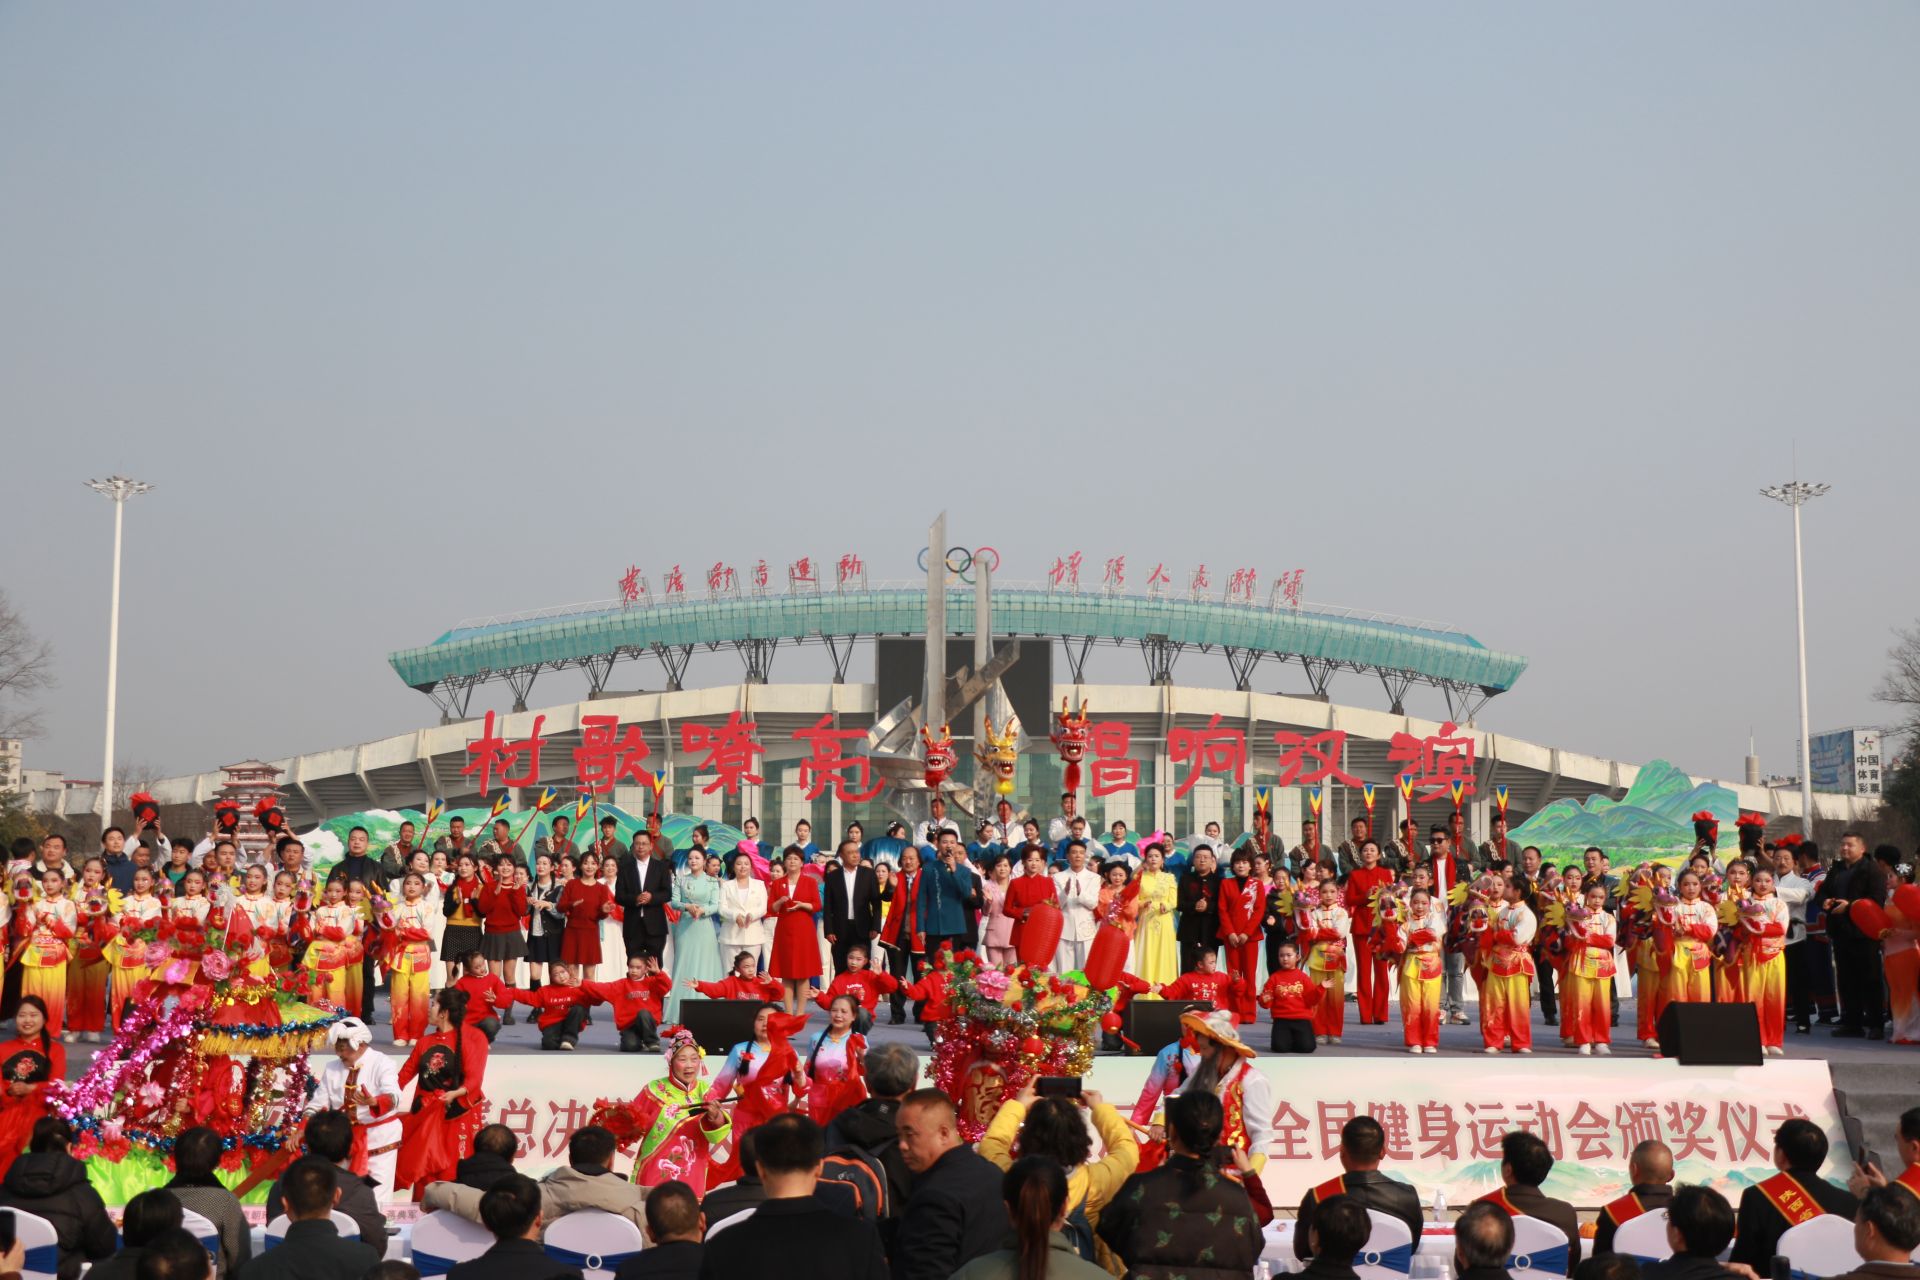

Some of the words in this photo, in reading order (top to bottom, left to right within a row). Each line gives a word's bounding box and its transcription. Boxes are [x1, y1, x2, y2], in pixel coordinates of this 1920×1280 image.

[460, 709, 887, 802] 村歌嘹亮
[1856, 754, 1879, 766] 中国
[1857, 768, 1879, 780] 体育
[1858, 783, 1880, 794] 彩票
